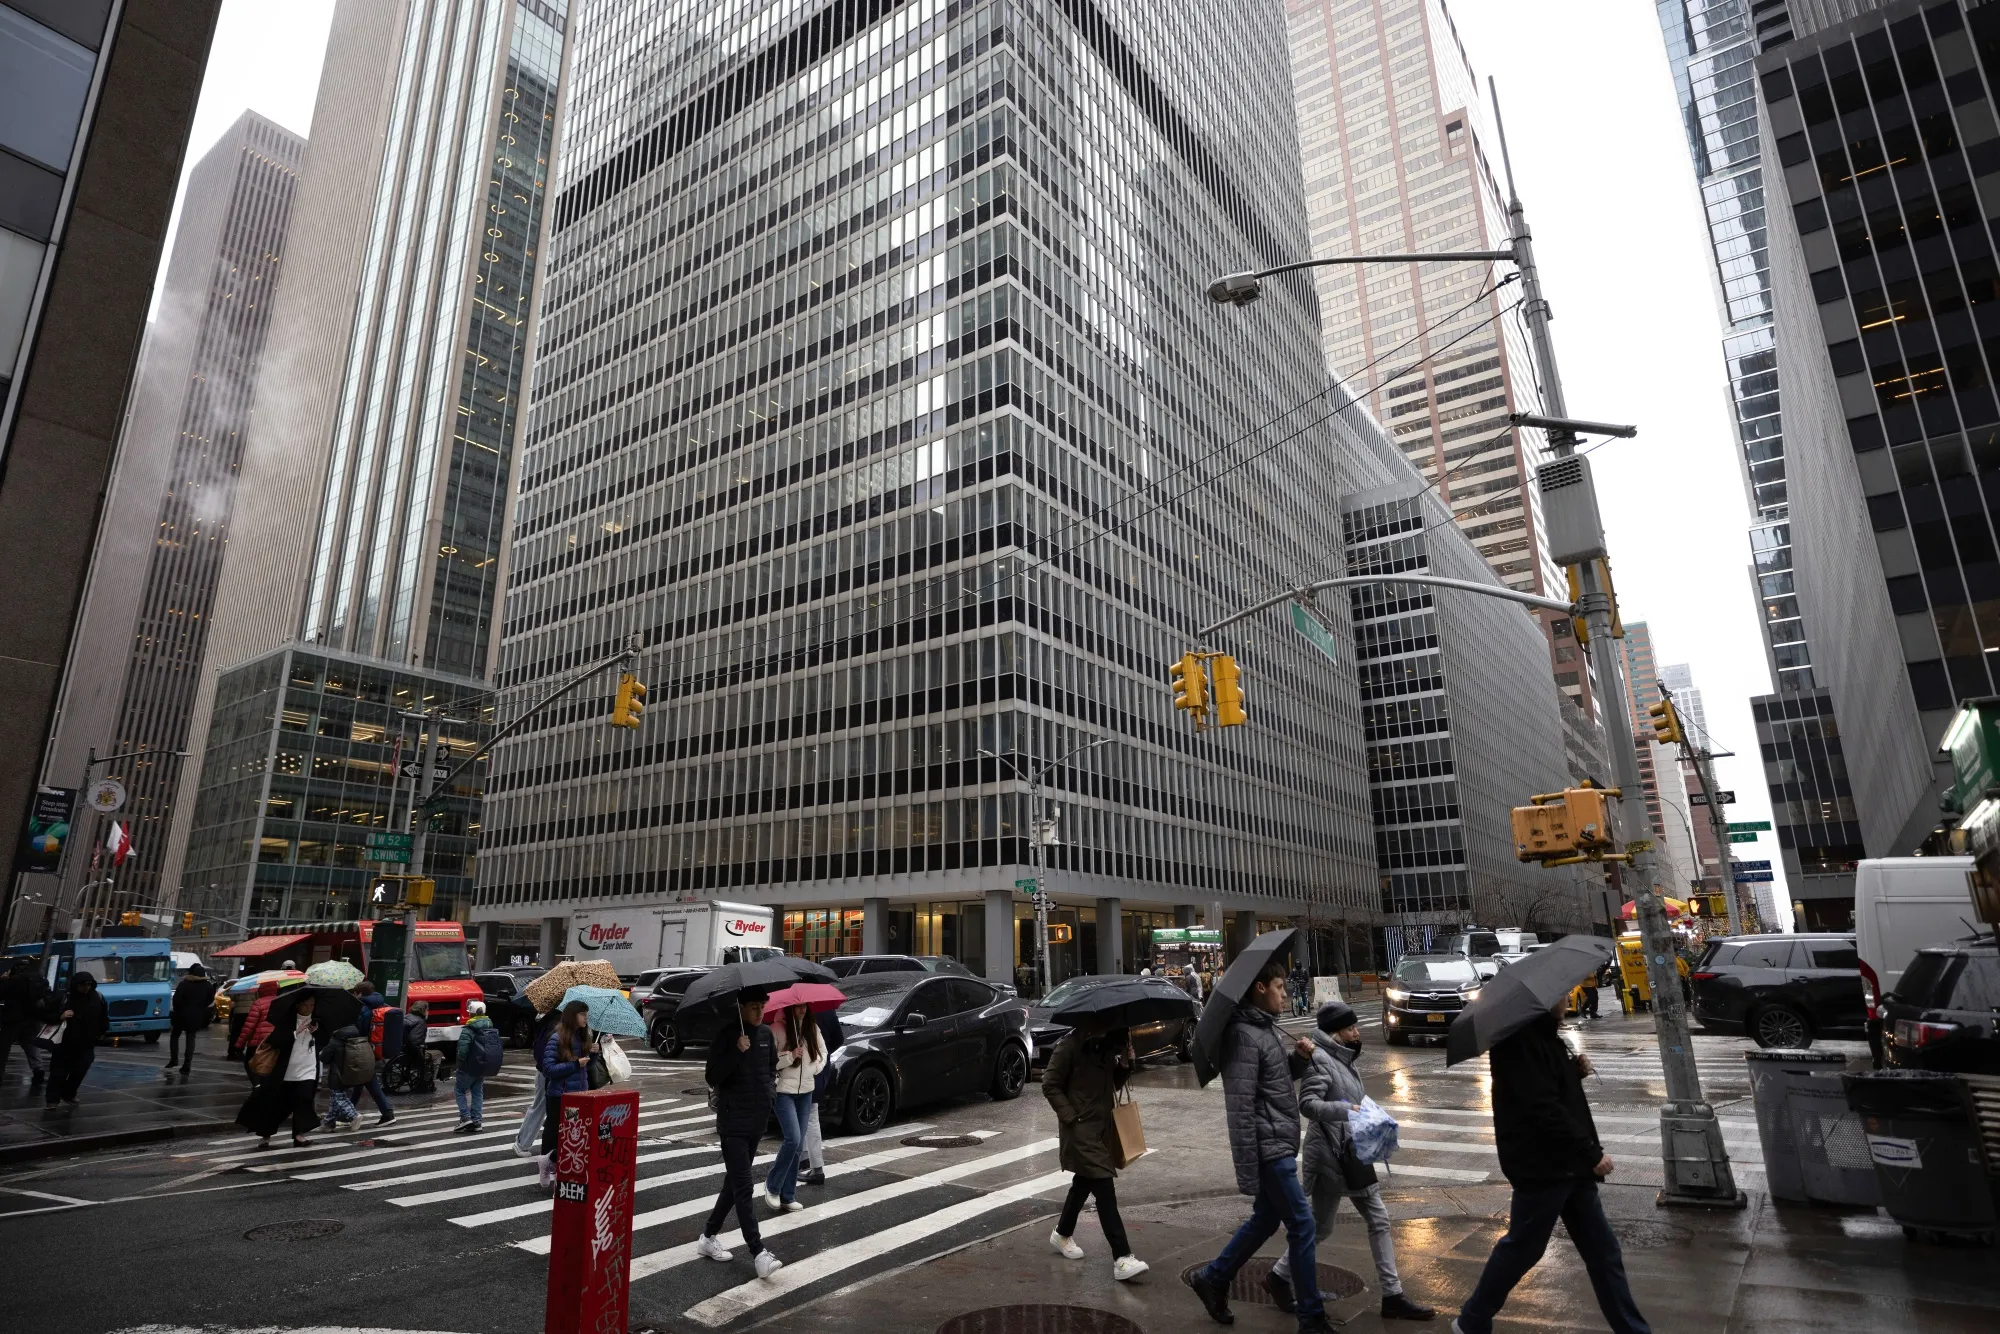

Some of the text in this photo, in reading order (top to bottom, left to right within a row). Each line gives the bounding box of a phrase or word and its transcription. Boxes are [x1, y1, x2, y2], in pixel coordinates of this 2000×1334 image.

[41, 799, 56, 808] Step
[429, 821, 434, 829] 6
[1732, 824, 1767, 832] AMERICAS
[377, 835, 386, 845] W
[388, 835, 400, 846] 52
[1738, 834, 1744, 842] 6
[374, 849, 399, 861] SWING
[734, 920, 766, 934] Ryder
[589, 922, 630, 944] Ryder
[601, 940, 634, 951] Ever better.
